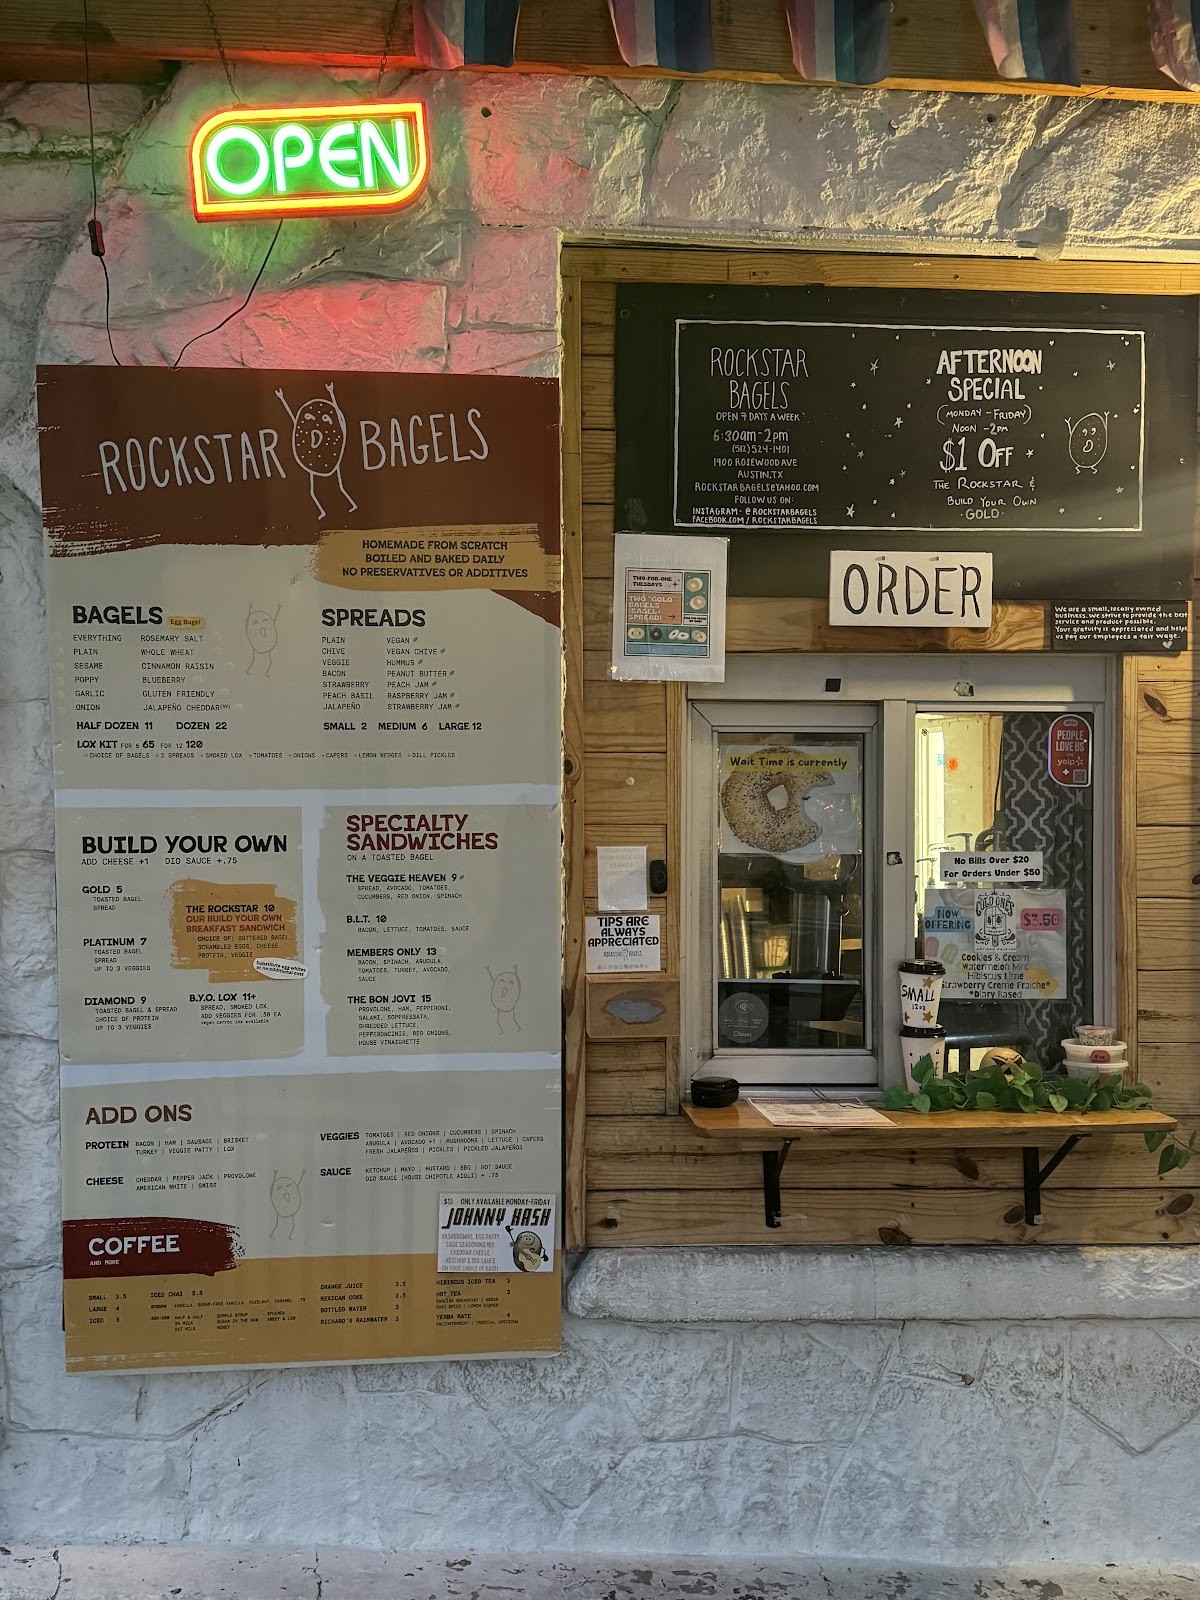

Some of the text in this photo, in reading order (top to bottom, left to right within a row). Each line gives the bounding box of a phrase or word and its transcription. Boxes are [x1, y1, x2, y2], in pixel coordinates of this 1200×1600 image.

[206, 119, 410, 195] OPEN
[711, 347, 809, 377] ROCKSTAR
[936, 349, 1042, 375] AFTERNOON
[948, 378, 1025, 401] SPECIAL
[730, 380, 789, 410] BAGELS
[716, 412, 800, 421] OPEN 7 DAYS A WEEK
[99, 408, 489, 494] ROCKSTAR BAGELS
[940, 436, 967, 473] $1
[362, 540, 508, 550] HOMEMADE FROM SCRATCH
[366, 554, 505, 564] BOILED AND BAKED DAILY
[343, 568, 528, 578] NO PRESERVATIVES OR ADDITIVES
[843, 563, 981, 618] ORDER
[73, 606, 163, 624] BAGELS
[322, 609, 426, 627] SPREADS
[1073, 626, 1101, 634] gratuity
[1112, 626, 1153, 634] appreciated
[77, 722, 227, 730] HALF DOZEN 11 DOZEN 22
[1058, 730, 1084, 740] PEOPLE
[1056, 742, 1084, 751] LOVE US
[731, 758, 847, 770] Wait Time is currently
[1057, 758, 1075, 766] yelp
[347, 814, 468, 832] SPECIALTY
[82, 835, 287, 854] BUILD YOUR OWN
[347, 833, 499, 851] SANDWICHES
[186, 857, 211, 865] SAUCE
[217, 857, 237, 865] +.75
[1013, 856, 1029, 864] $20
[1024, 868, 1040, 876] $50
[368, 874, 406, 882] VEGGIE
[408, 874, 446, 882] HEAVEN
[82, 886, 110, 894] GOLD
[186, 905, 205, 913] THE
[347, 915, 370, 923] B.L.T.
[937, 910, 959, 919] NOW
[597, 916, 649, 926] TIPS ARE
[925, 920, 971, 929] OFFERING
[1023, 913, 1059, 927] $3.50
[186, 924, 285, 932] BREAKFAST SANDWICH
[601, 927, 645, 937] ALWAYS
[83, 938, 135, 946] PLATINUM
[588, 937, 658, 947] APPRECIATED
[397, 948, 421, 956] ONLY
[189, 993, 256, 1002] B.Y.O. LOX 11+
[902, 985, 935, 1002] SMALL
[85, 996, 147, 1005] DIAMOND 9
[348, 996, 366, 1004] THE
[369, 995, 389, 1003] BON
[391, 995, 415, 1003] JOVI
[85, 1104, 192, 1125] ADD ONS
[320, 1132, 359, 1141] VEGGIES
[86, 1140, 129, 1150] PROTEIN
[320, 1168, 351, 1176] SAUCE
[86, 1177, 124, 1186] CHEESE
[442, 1208, 551, 1229] JOHNNY HASH
[88, 1234, 181, 1256] COFFEE
